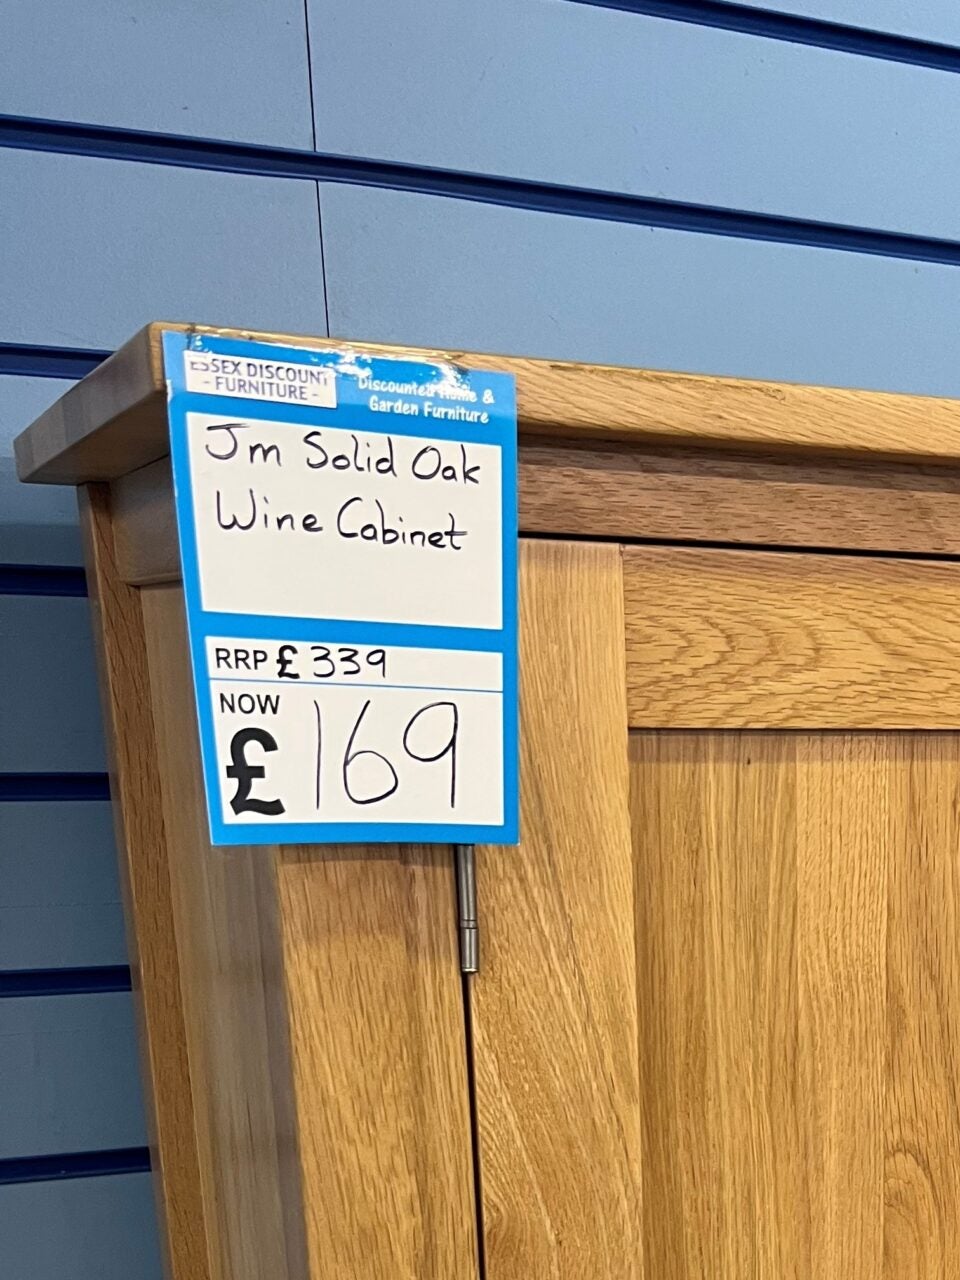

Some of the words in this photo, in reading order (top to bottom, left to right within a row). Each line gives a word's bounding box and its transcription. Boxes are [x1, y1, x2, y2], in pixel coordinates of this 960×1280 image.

[215, 376, 308, 401] FURNITURE
[482, 389, 495, 404] &
[369, 395, 419, 416] Garden
[423, 401, 489, 424] Furniture
[303, 431, 397, 478] Solid
[411, 444, 481, 485] Oak
[216, 489, 323, 532] Wine
[337, 497, 468, 550] Cabinet
[215, 648, 268, 671] RRP
[276, 644, 387, 679] £339
[220, 693, 280, 715] NOW
[226, 700, 459, 816] £169
